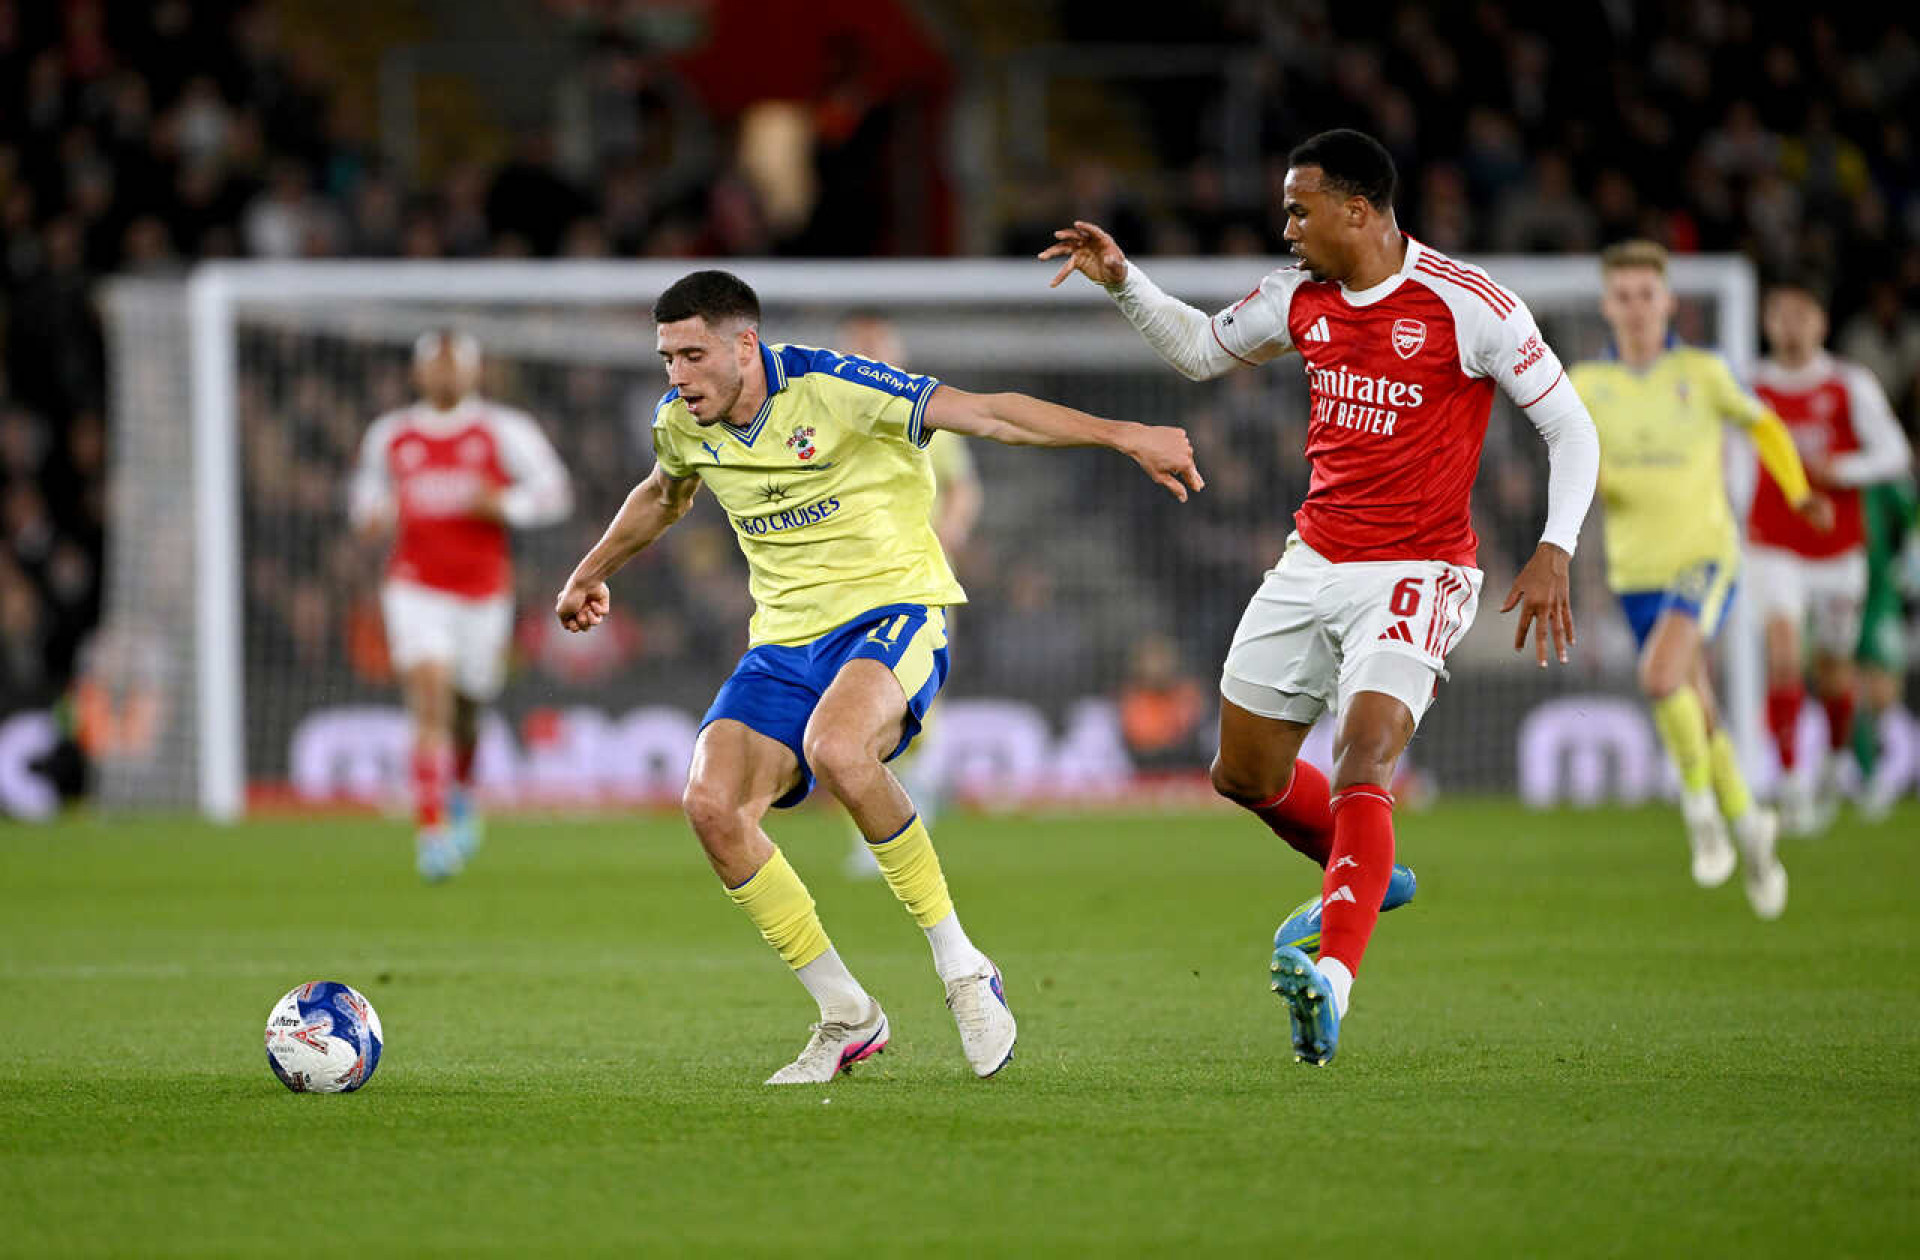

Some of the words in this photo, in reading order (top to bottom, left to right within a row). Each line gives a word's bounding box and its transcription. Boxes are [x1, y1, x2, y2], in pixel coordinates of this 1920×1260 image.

[857, 365, 920, 393] GARMN
[1337, 402, 1398, 436] BETTER
[769, 495, 841, 531] CRUISES
[1390, 578, 1423, 616] 6
